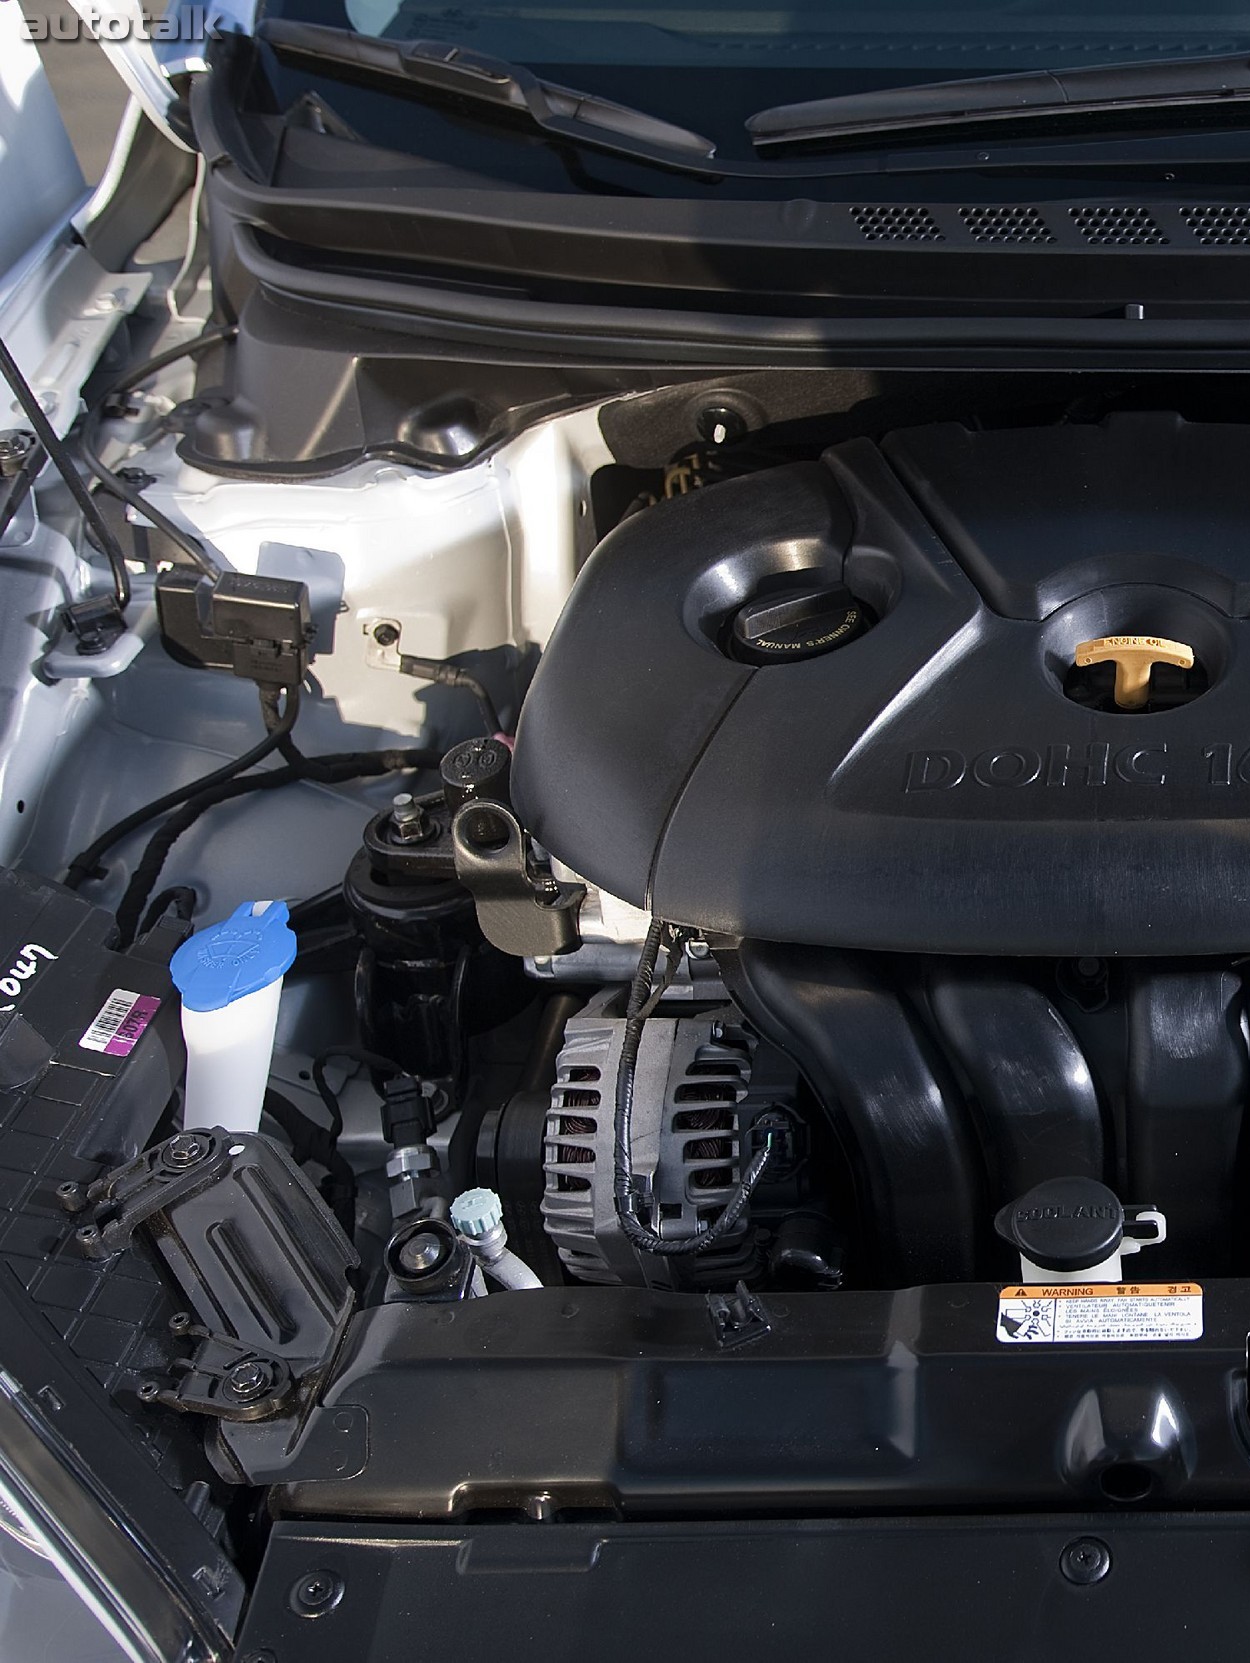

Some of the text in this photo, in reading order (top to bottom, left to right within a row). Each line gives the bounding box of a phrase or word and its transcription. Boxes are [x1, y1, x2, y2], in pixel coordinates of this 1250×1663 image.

[756, 638, 801, 649] MANUAL
[904, 742, 1168, 795] DOHC
[1042, 1287, 1094, 1296] WARNING
